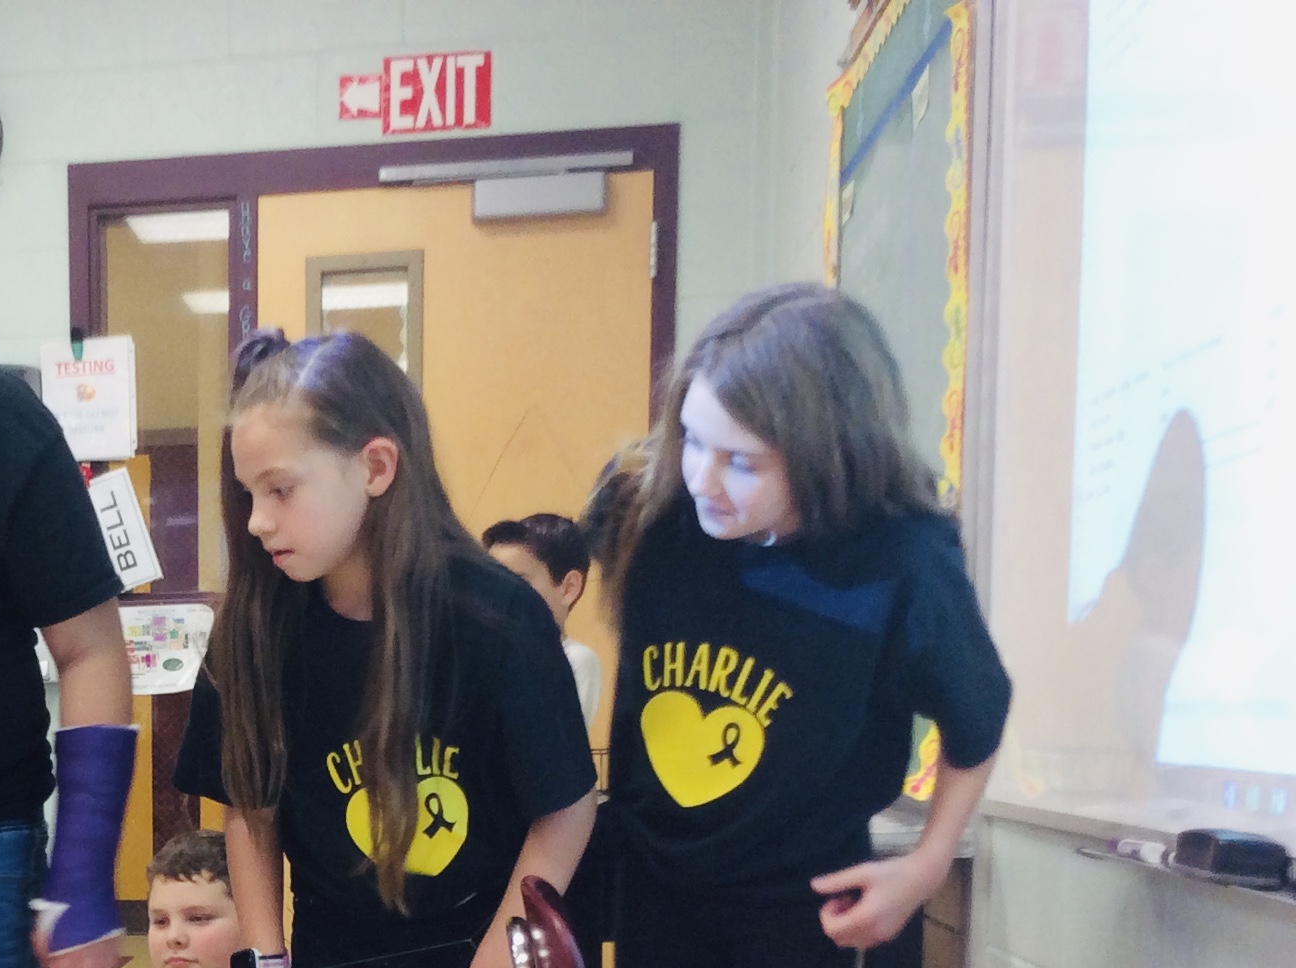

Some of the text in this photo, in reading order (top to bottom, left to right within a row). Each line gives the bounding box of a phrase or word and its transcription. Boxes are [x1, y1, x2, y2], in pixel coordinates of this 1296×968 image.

[389, 53, 485, 130] EXIT
[55, 359, 115, 377] TESTING
[100, 490, 138, 572] BELL
[641, 641, 794, 728] CHARLIE
[326, 733, 460, 794] CHLIE
